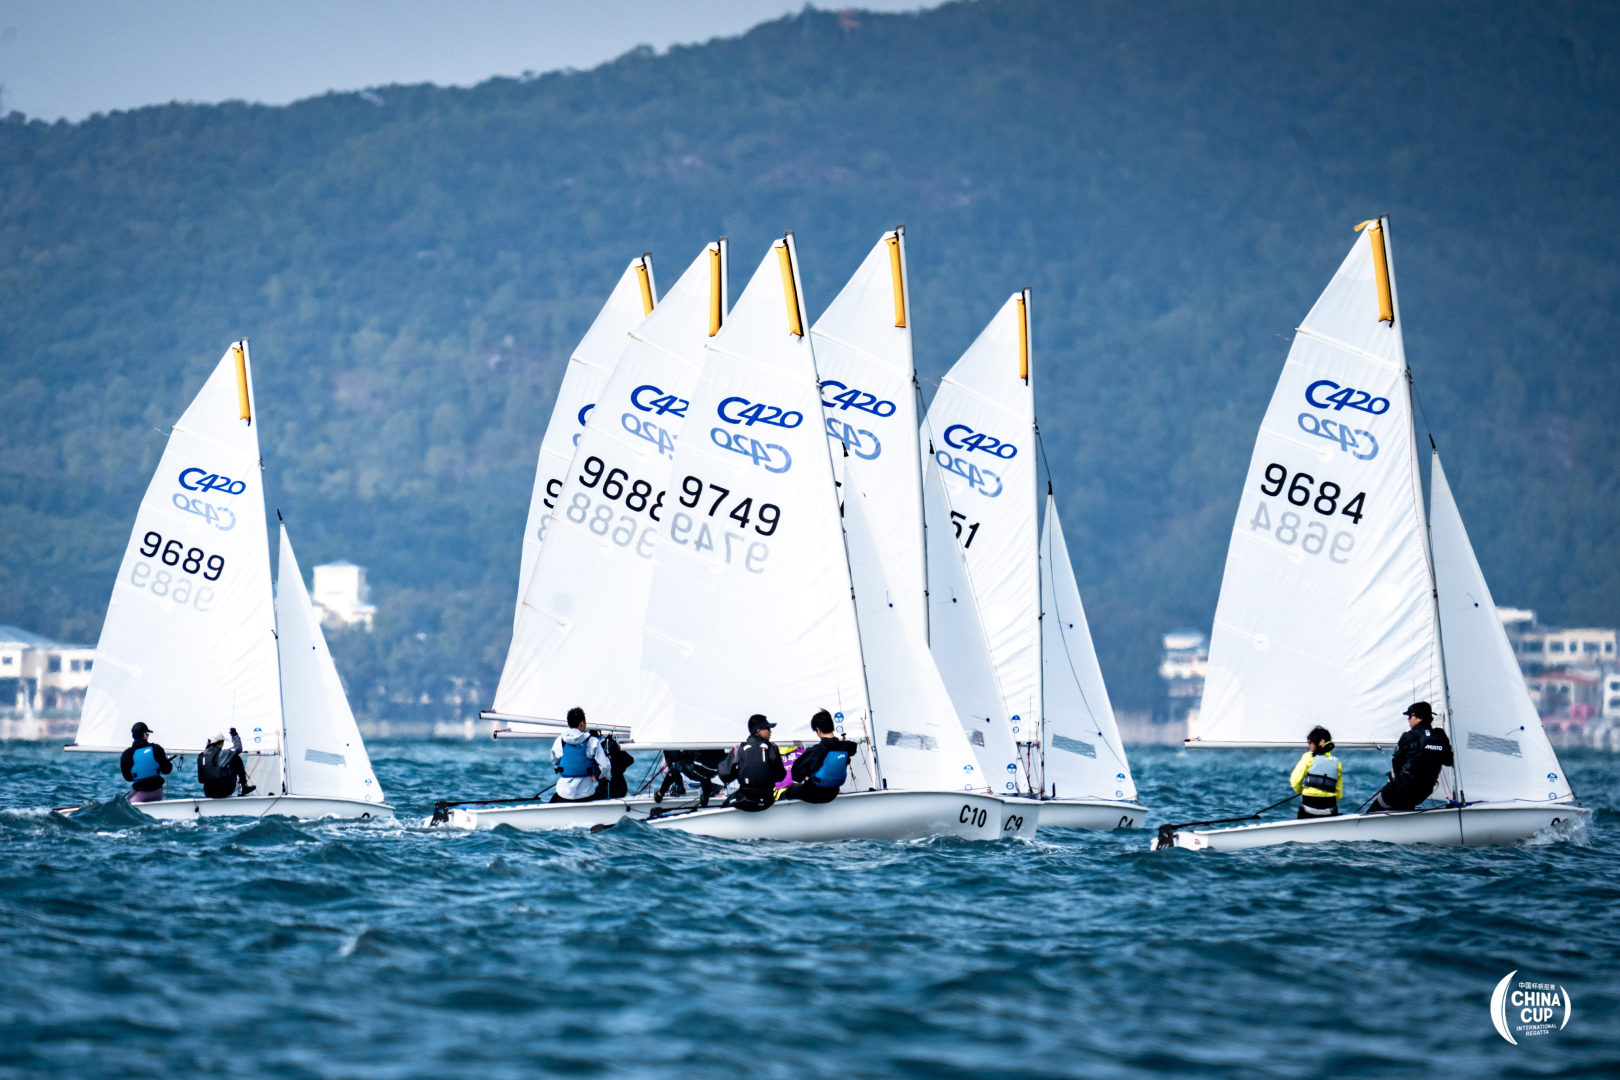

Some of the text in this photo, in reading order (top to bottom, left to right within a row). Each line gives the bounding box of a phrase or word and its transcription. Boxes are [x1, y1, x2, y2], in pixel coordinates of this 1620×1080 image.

[630, 384, 690, 418] C42
[717, 396, 804, 428] C420
[820, 380, 897, 417] C420
[1305, 380, 1391, 415] C420
[943, 424, 1018, 459] C420
[179, 467, 247, 495] C420
[1260, 463, 1367, 525] 9684
[678, 475, 781, 536] 9749
[139, 531, 225, 581] 9689
[959, 804, 988, 828] C10
[1003, 814, 1024, 831] C9
